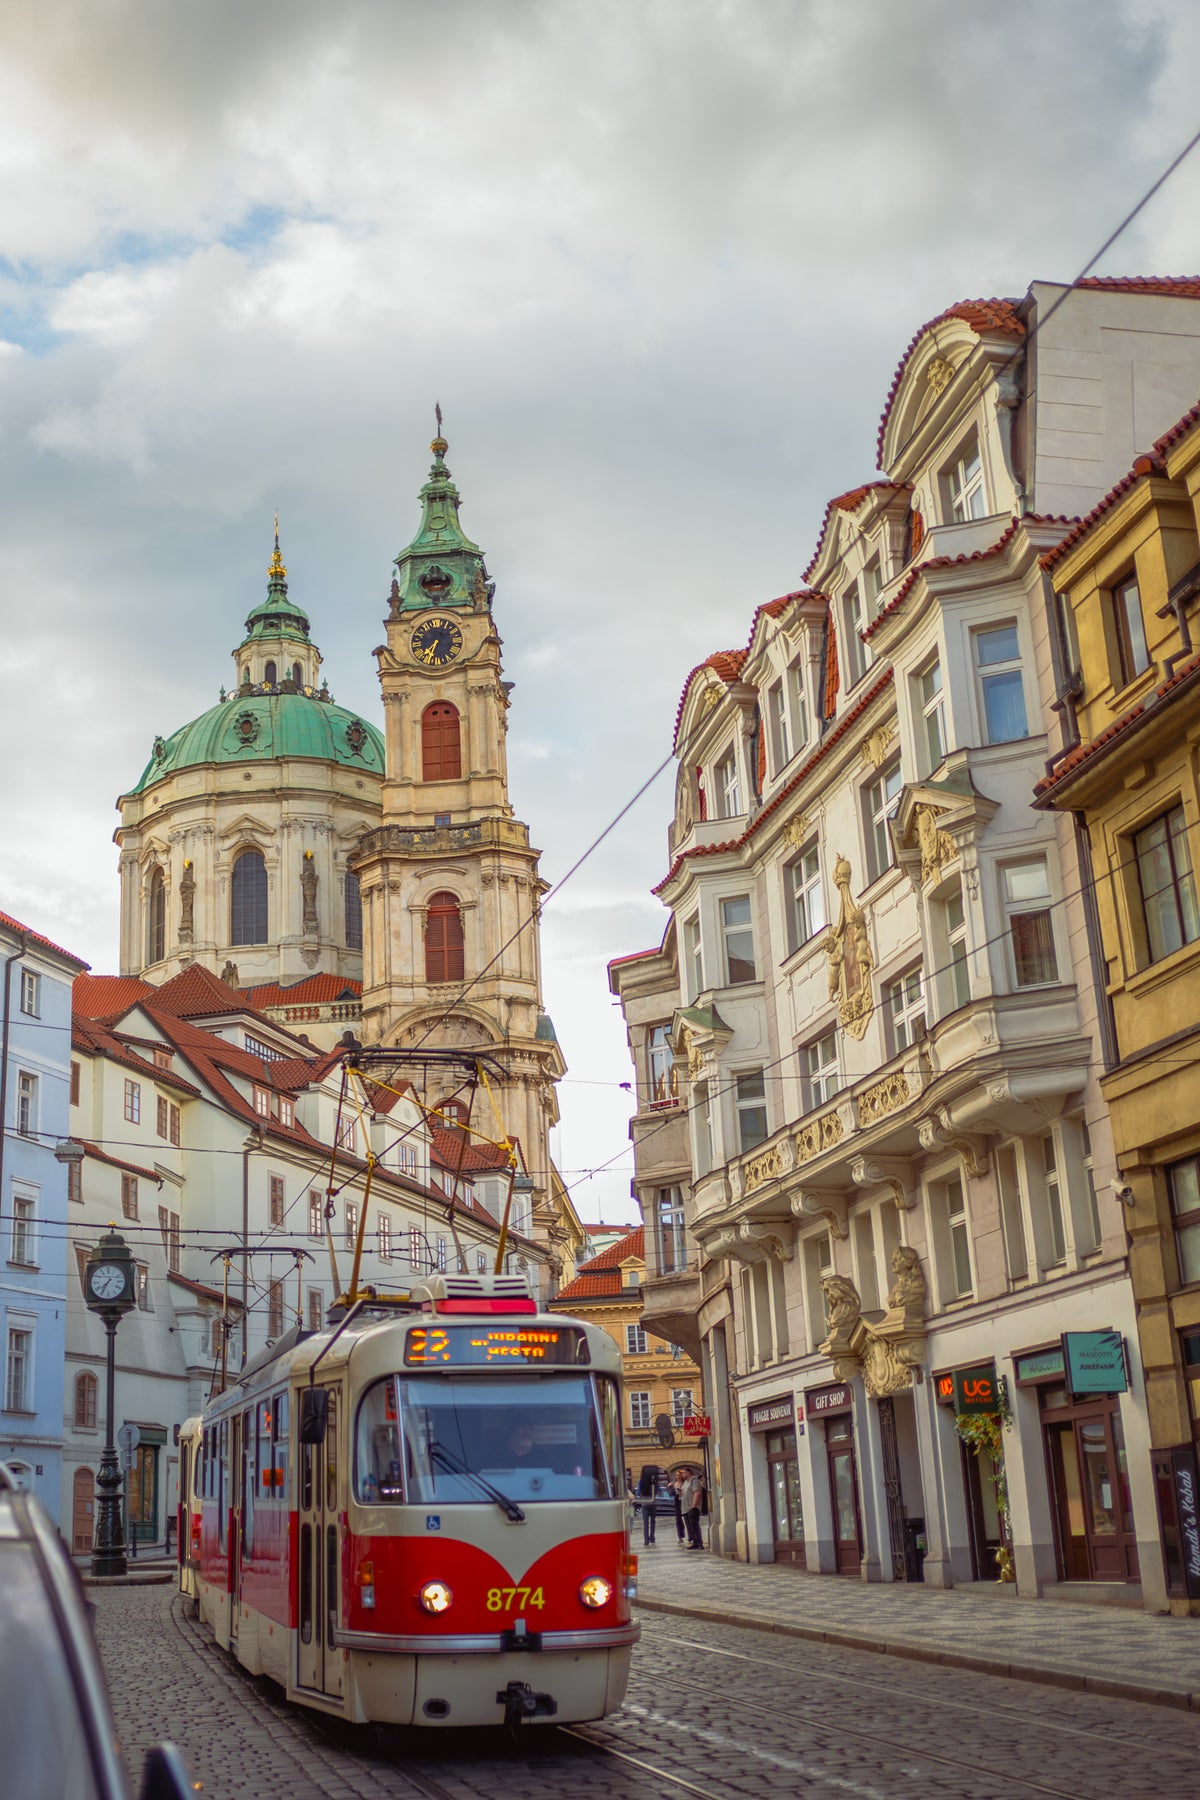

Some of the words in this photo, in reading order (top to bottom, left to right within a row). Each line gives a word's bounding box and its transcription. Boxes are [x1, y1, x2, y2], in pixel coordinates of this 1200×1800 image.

[963, 1379, 991, 1397] UC
[815, 1394, 828, 1410] GIFT
[829, 1391, 845, 1406] SHOP
[687, 1417, 707, 1425] ART
[753, 1408, 770, 1424] PRAGUE
[770, 1404, 791, 1420] SOUVENIR
[1177, 1470, 1195, 1513] Kebab
[486, 1587, 545, 1612] 8774
